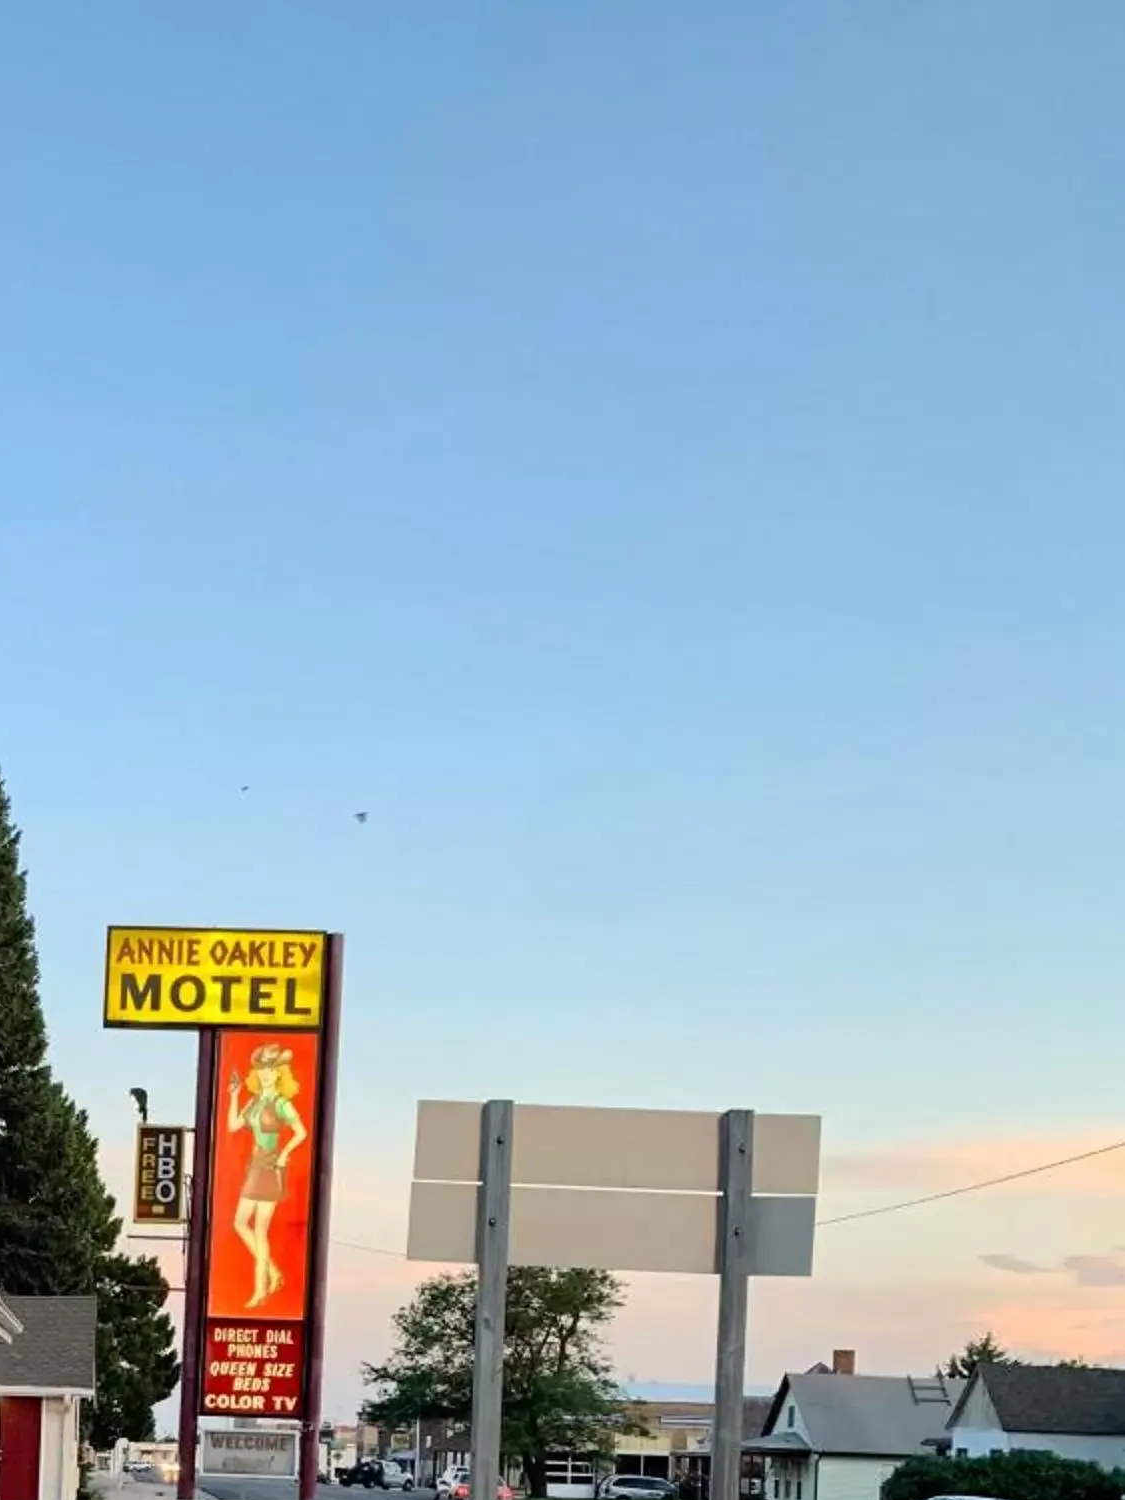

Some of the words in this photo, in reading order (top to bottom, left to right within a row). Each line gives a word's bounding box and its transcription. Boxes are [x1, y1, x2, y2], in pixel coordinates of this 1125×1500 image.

[116, 937, 201, 966] ANNIE
[209, 940, 317, 968] OAKLEY
[119, 972, 312, 1016] MOTEL
[141, 1137, 155, 1200] FREE
[156, 1133, 177, 1203] HBO
[214, 1328, 259, 1342] DIRECT
[266, 1330, 294, 1344] DIAL
[227, 1343, 278, 1358] PHONES
[210, 1361, 257, 1377] QUEEN
[263, 1362, 295, 1377] SIZE
[232, 1377, 271, 1391] BEDS
[204, 1393, 265, 1409] COLOR
[272, 1396, 297, 1411] TV
[211, 1434, 287, 1451] WELCOME
